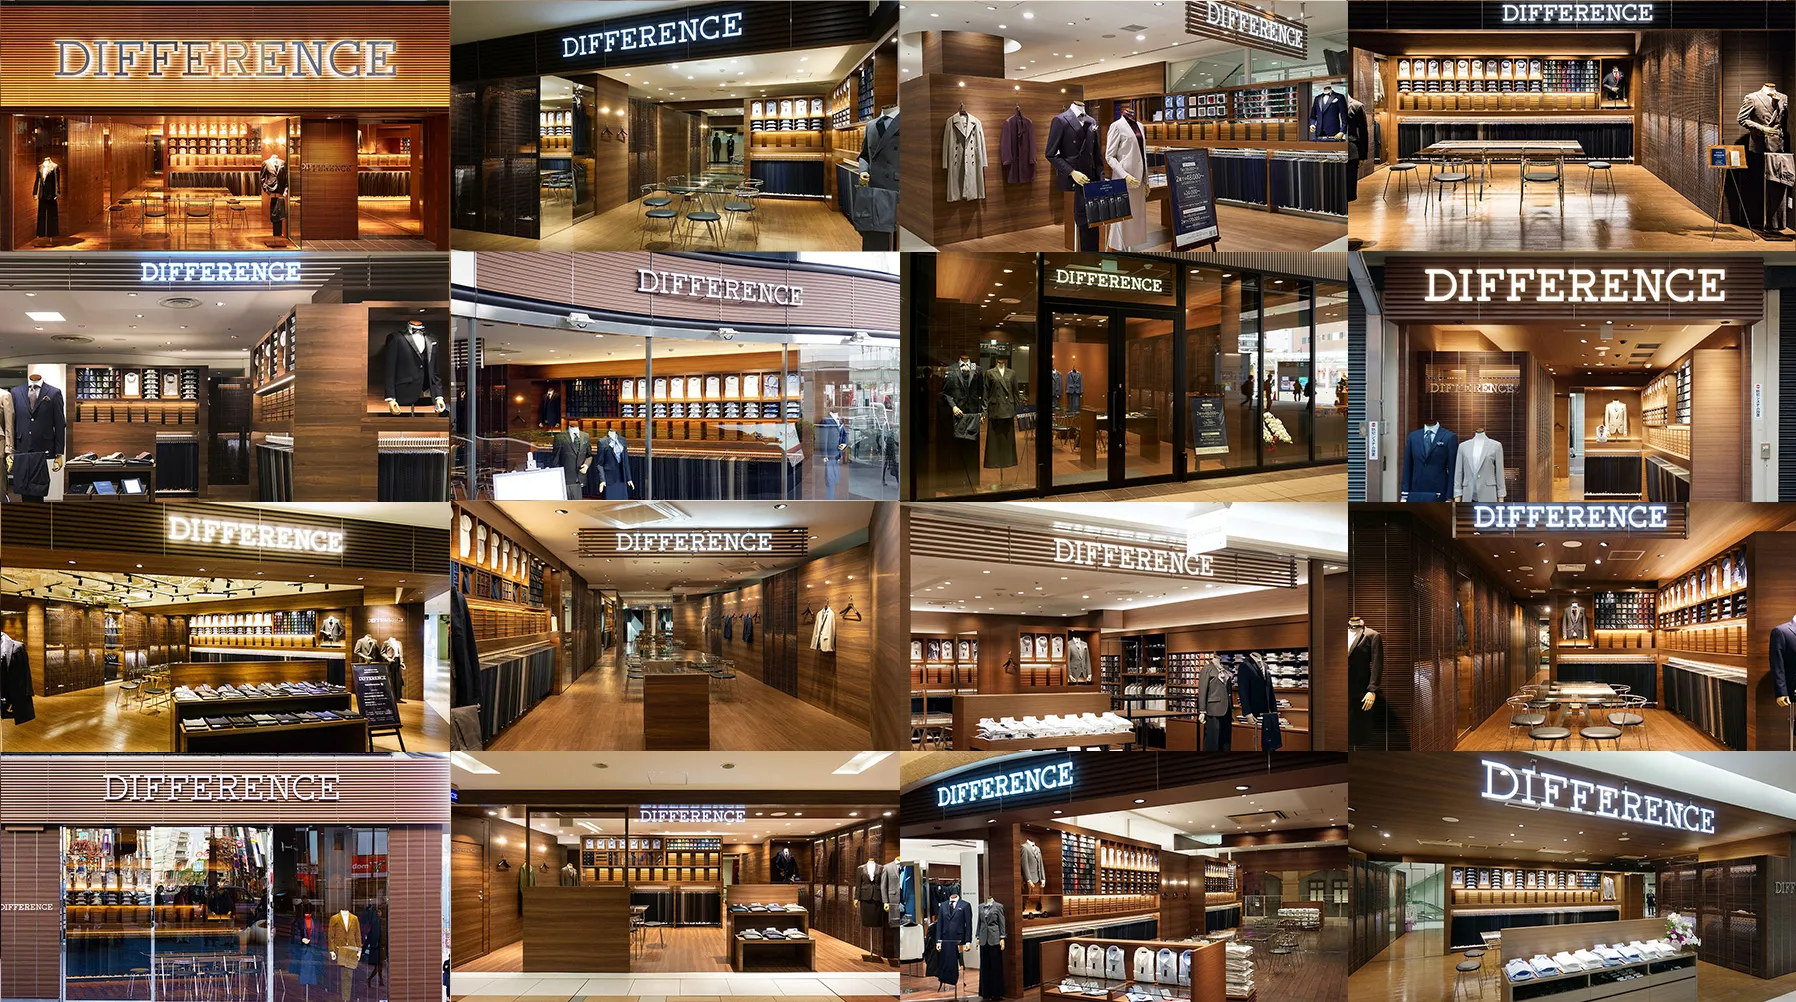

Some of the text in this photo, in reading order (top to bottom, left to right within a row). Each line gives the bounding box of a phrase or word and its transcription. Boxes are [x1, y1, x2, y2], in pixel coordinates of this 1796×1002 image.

[1206, 1, 1303, 48] DIFFERENCE
[1502, 4, 1653, 22] DIFFERENCE
[562, 12, 742, 58] DIFFERENCE
[55, 41, 397, 77] DIFFERENCE
[140, 262, 301, 281] DIFFERENCE
[637, 269, 803, 306] DIFFERENCE
[1056, 269, 1163, 292] DIFFERENCE
[1425, 268, 1726, 303] DIFFERENCE
[1473, 505, 1668, 528] DIFFERENCE
[168, 516, 344, 553] DIFFERENCE
[616, 533, 773, 551] DIFFERENCE
[1053, 537, 1214, 577] DIFFERENCE
[103, 774, 340, 800] DIFFERENCE
[937, 761, 1074, 806] DIFFERENCE
[1481, 759, 1716, 835] DIFFERENCE
[639, 810, 746, 823] DIFFERENCE
